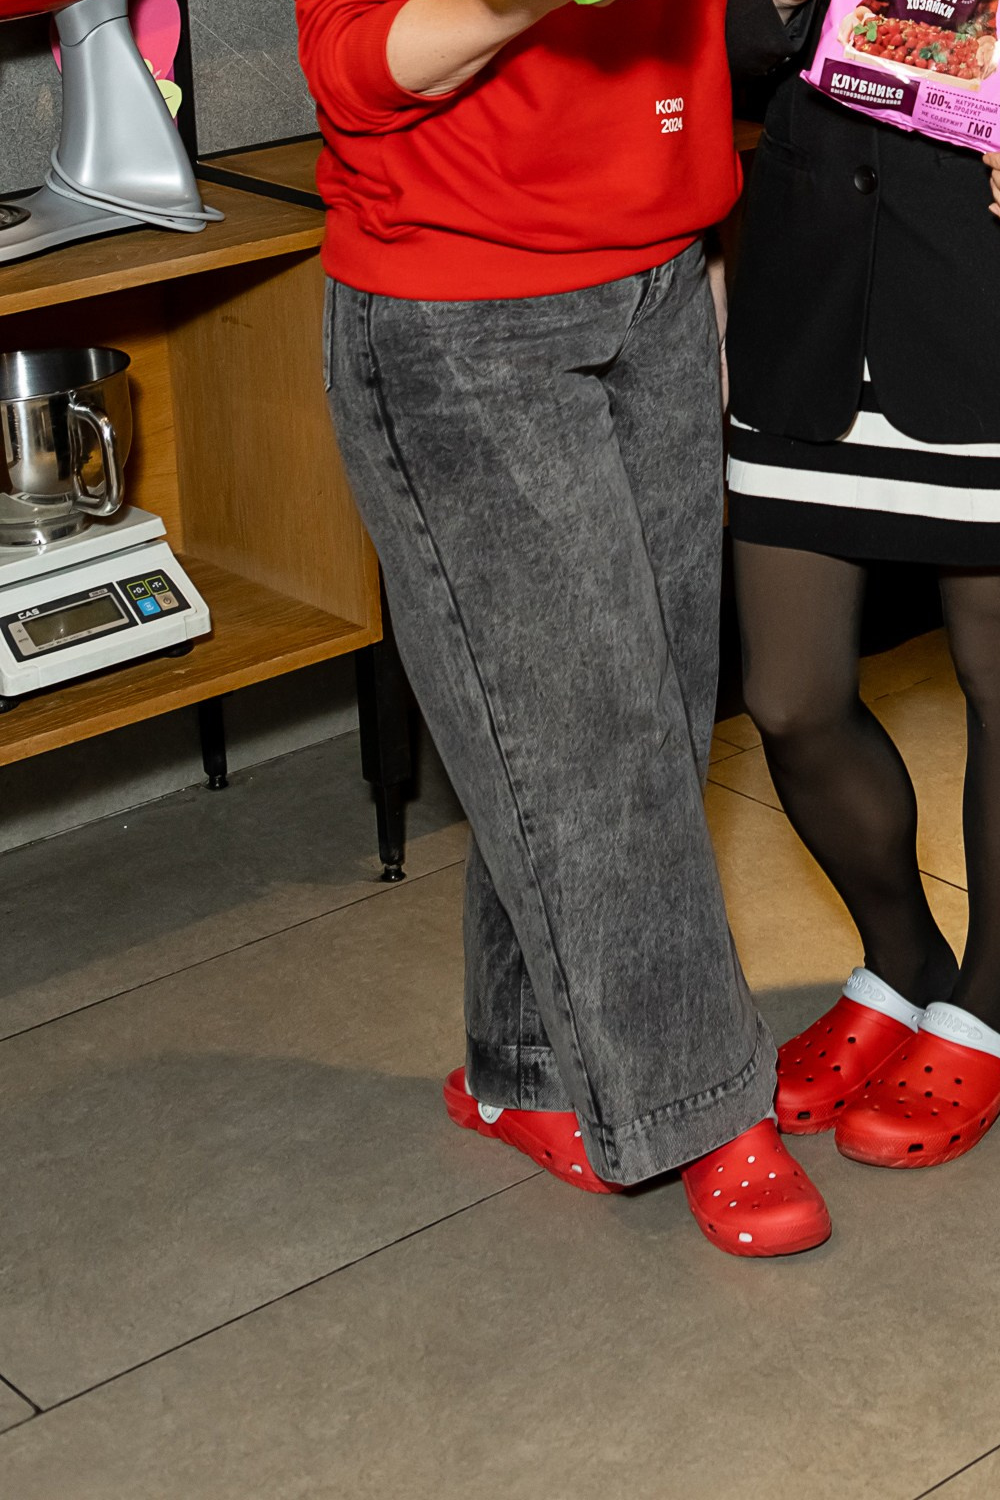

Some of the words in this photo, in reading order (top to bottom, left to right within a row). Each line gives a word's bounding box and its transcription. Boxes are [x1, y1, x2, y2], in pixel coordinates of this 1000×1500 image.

[656, 98, 684, 115] KOKO
[925, 92, 952, 109] 100%
[956, 99, 998, 114] НАТУРАЛЬНЫЙ
[953, 105, 981, 117] ПРОДУКТ
[660, 117, 683, 133] 2024
[930, 114, 963, 128] СОДЕРЖИТ
[967, 121, 992, 138] ГМО
[18, 608, 40, 619] CAS
